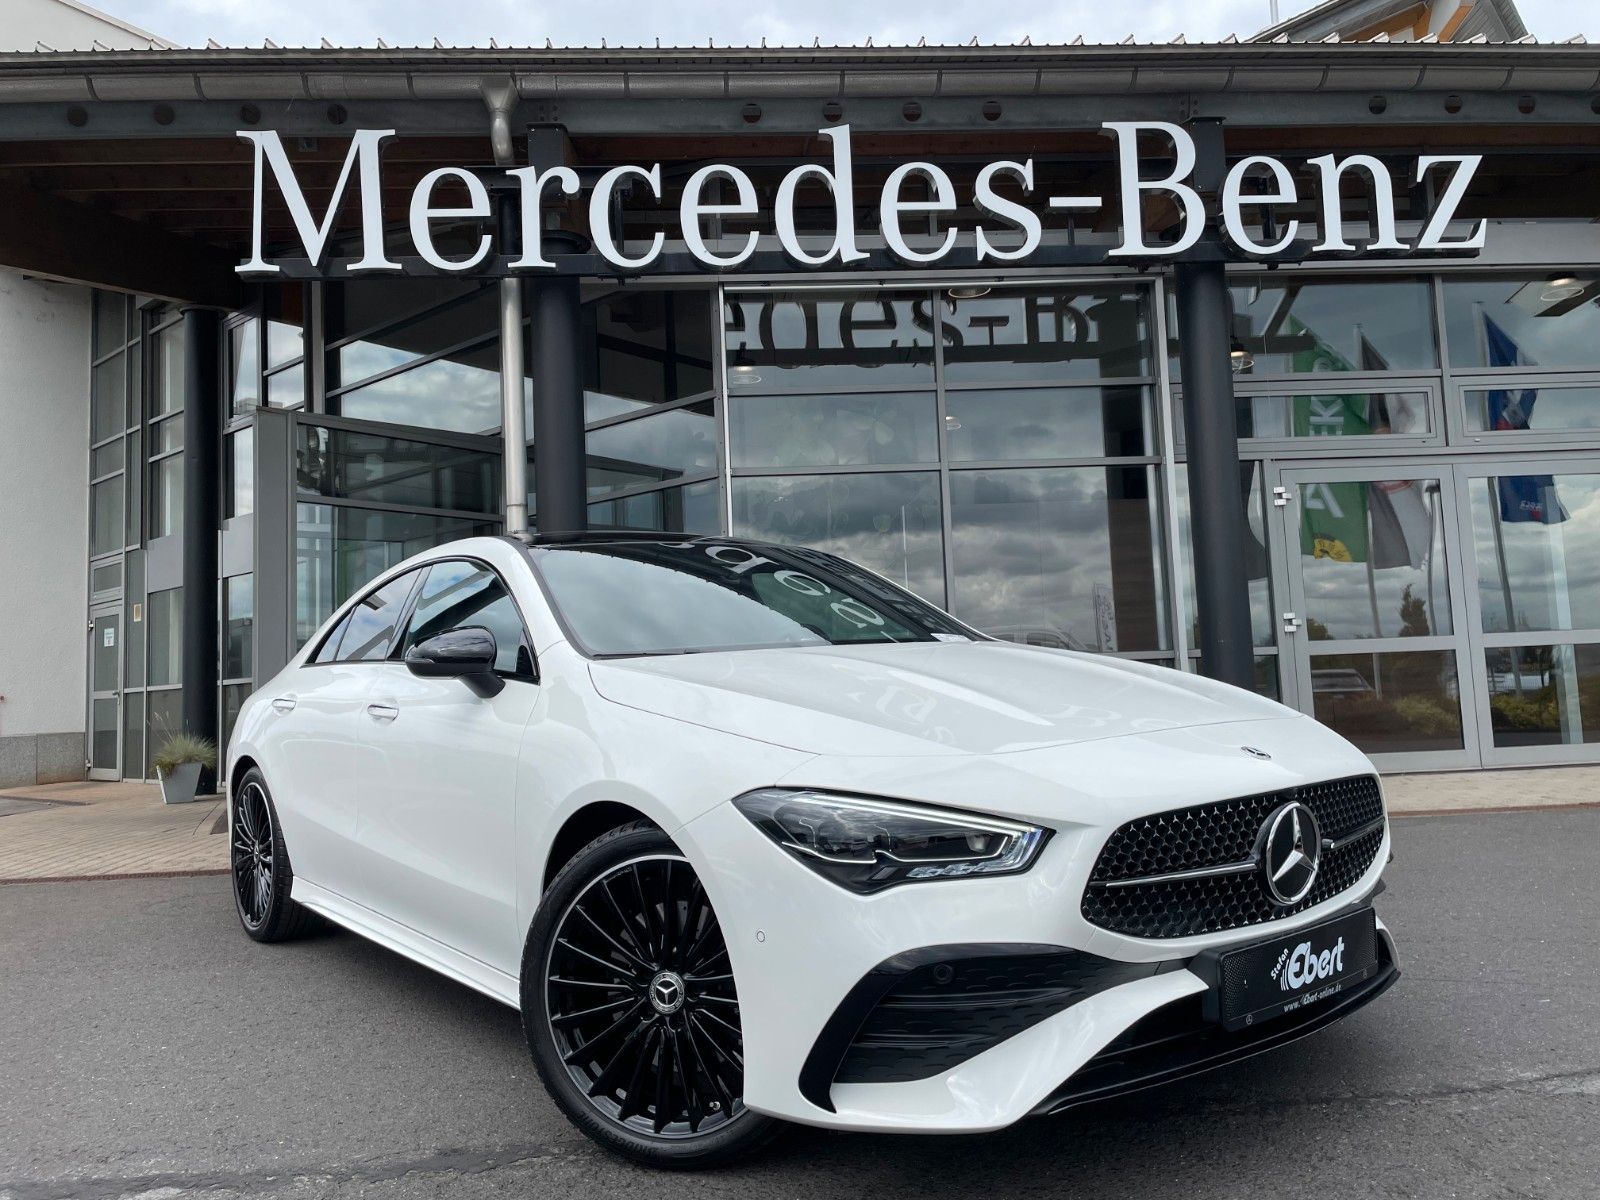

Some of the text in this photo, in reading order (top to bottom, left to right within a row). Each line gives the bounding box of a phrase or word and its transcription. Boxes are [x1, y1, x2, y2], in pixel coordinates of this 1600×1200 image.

[235, 122, 1487, 272] Mercedes-Benz
[1271, 948, 1289, 980] Stefan
[1287, 936, 1344, 989] Ebert
